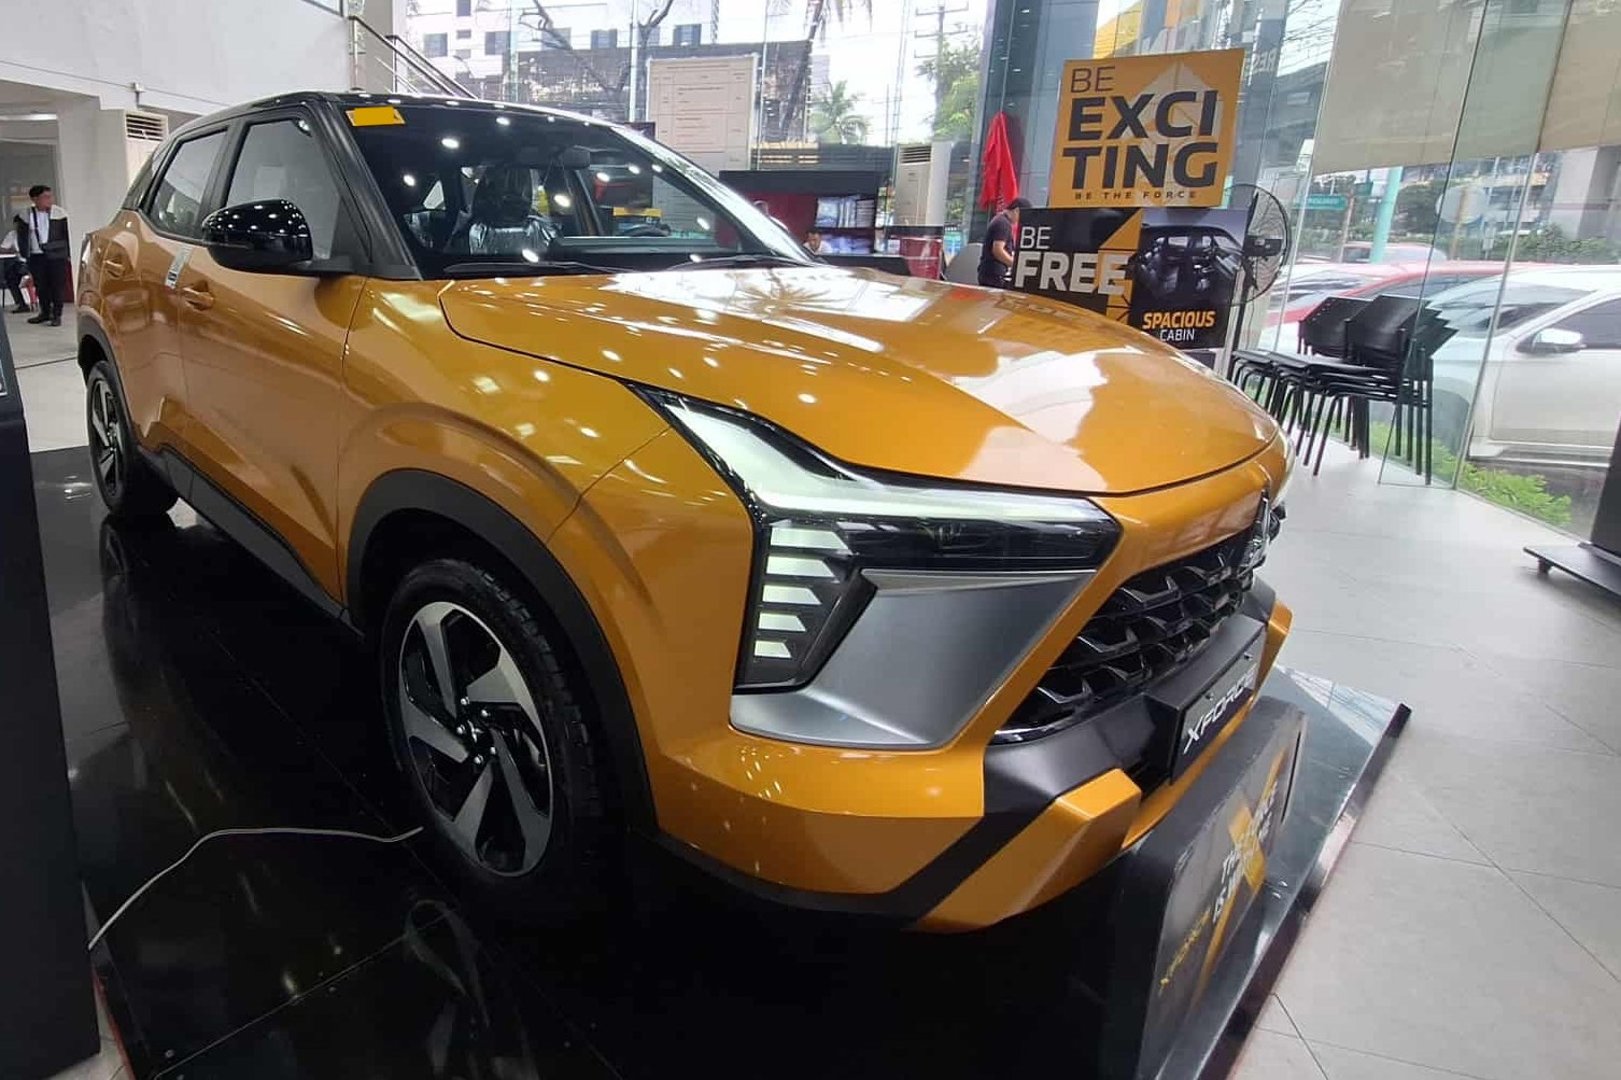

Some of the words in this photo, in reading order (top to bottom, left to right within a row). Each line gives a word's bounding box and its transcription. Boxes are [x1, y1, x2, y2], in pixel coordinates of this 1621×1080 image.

[1070, 66, 1116, 93] BE
[1068, 90, 1218, 141] EXCI
[1062, 142, 1217, 190] TING
[1075, 192, 1093, 200] BE
[1103, 191, 1132, 199] THE
[1143, 191, 1197, 199] FORCE
[1019, 226, 1052, 249] BE
[1014, 251, 1129, 296] FREE
[1142, 310, 1216, 330] SPACIOUS
[1160, 328, 1195, 342] CABIN
[1183, 663, 1257, 755] XFORCE
